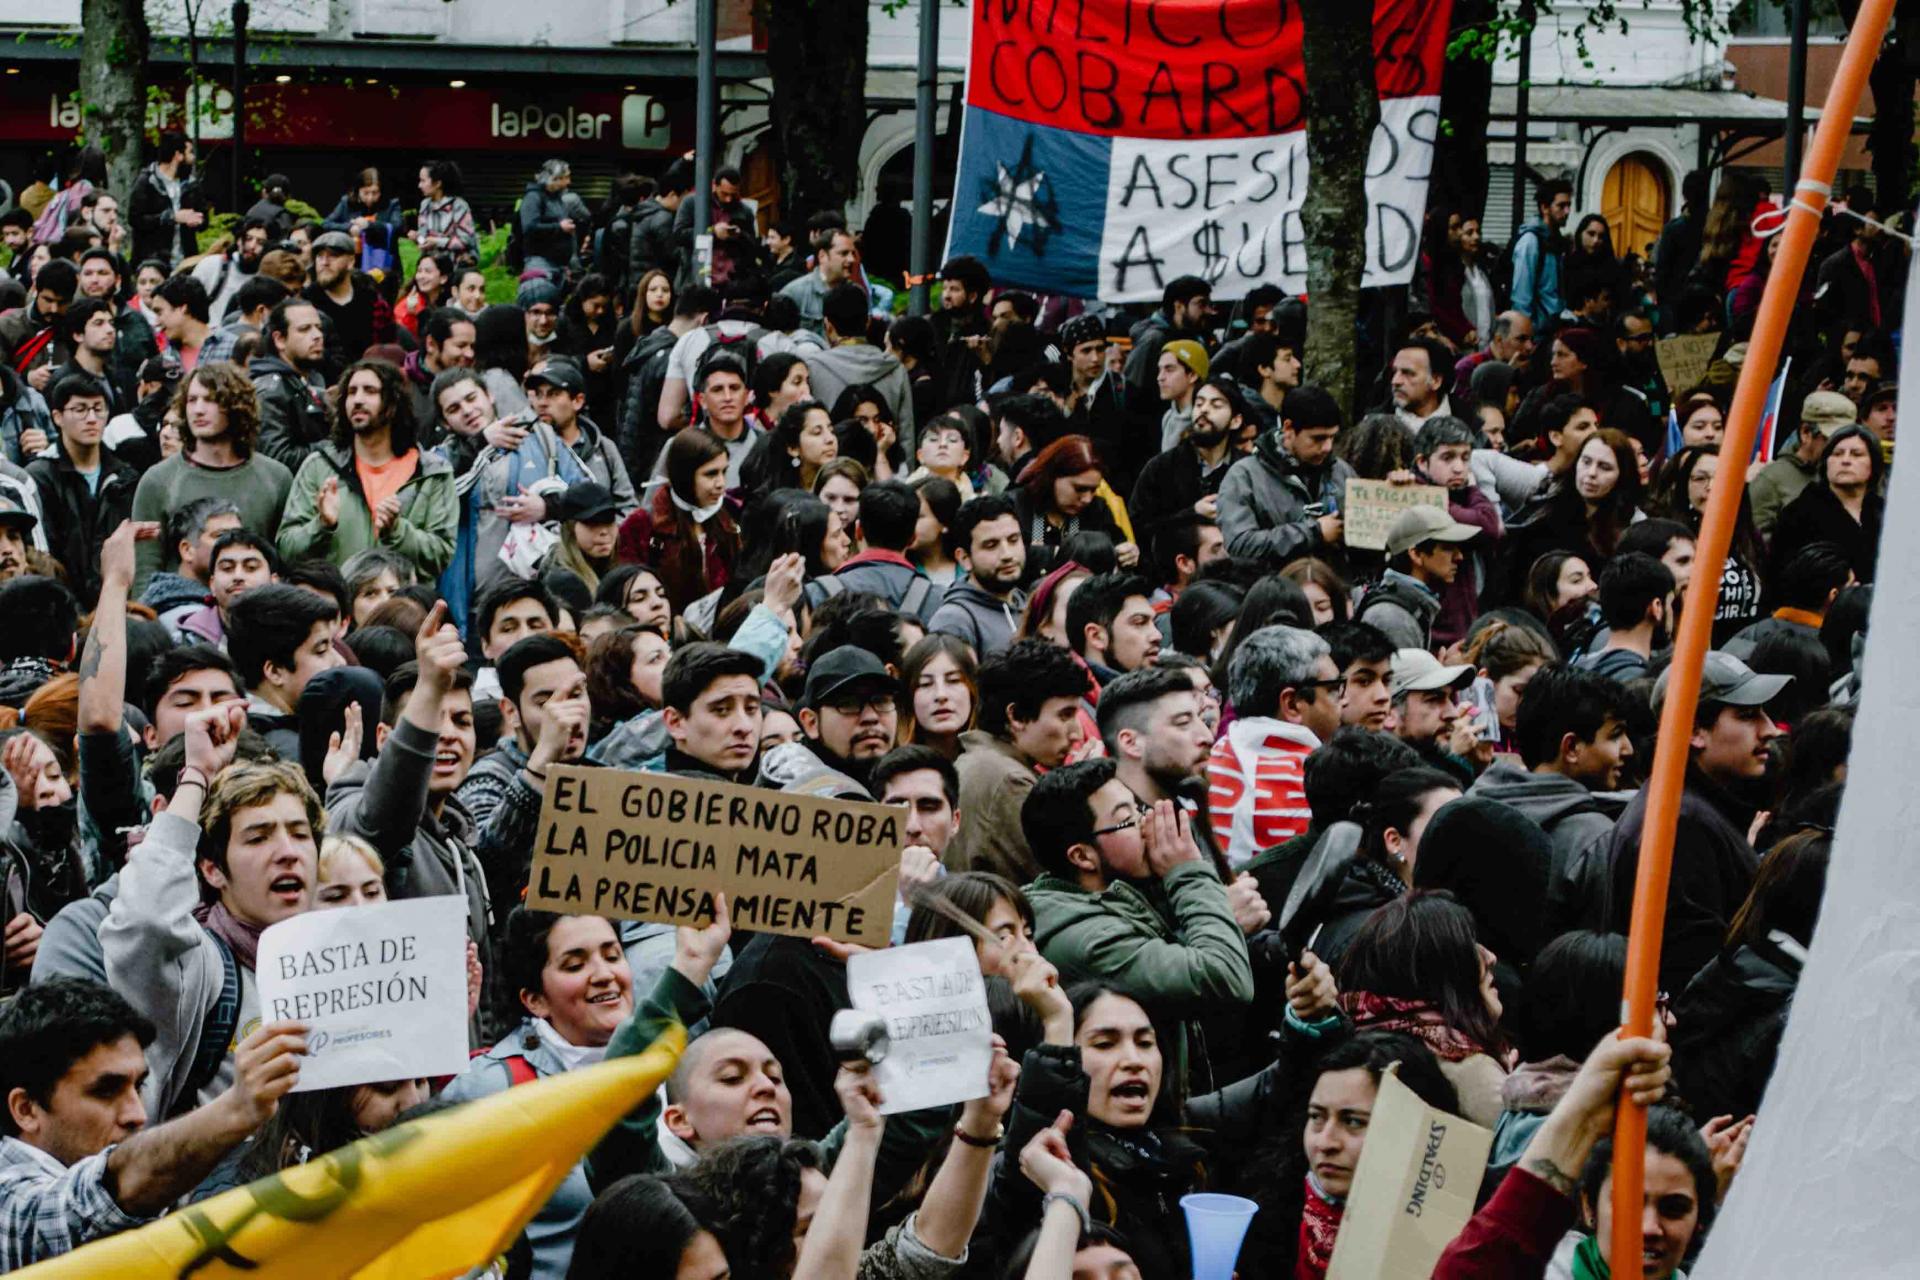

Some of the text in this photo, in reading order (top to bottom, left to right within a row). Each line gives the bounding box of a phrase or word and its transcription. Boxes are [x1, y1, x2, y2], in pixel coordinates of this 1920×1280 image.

[491, 102, 611, 139] laPolar
[990, 40, 1427, 135] COBARDS
[1118, 109, 1438, 210] ASESIOS
[1111, 225, 1166, 293] A
[554, 777, 898, 848] EL GOBIERNO ROBA
[545, 822, 817, 884] LA POLICIA MATA
[538, 867, 865, 935] LA PRENSA MIENTE
[279, 936, 416, 980] BASTA DE
[273, 971, 427, 1022] REPRESIÓN
[1406, 1121, 1446, 1218] SPALDING
